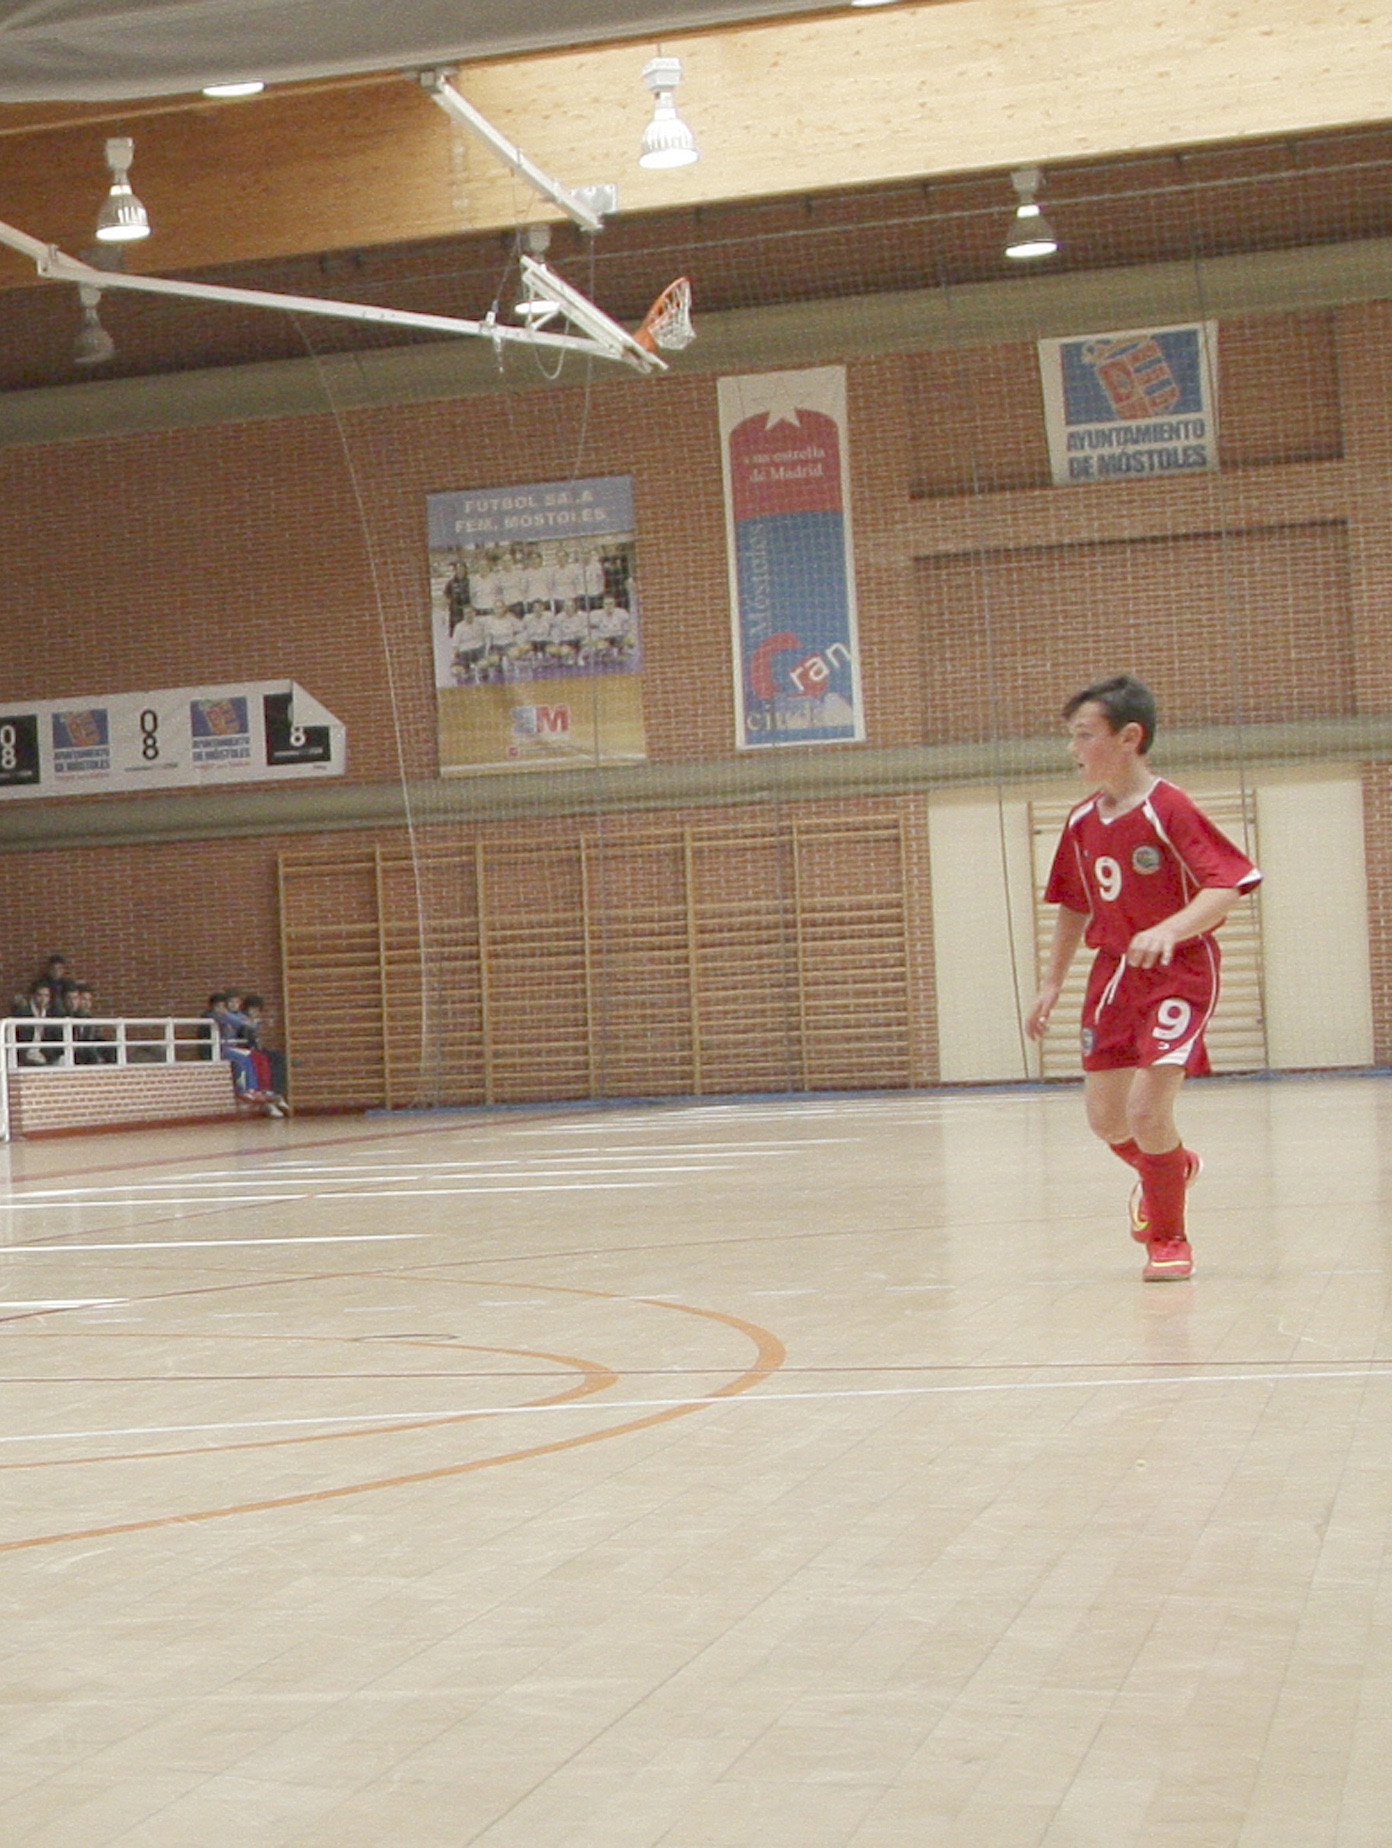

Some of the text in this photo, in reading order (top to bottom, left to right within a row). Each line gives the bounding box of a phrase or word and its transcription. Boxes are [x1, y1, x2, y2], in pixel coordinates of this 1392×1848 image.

[1067, 419, 1206, 451] AYUNTAMIENTO
[1069, 455, 1095, 479] DE
[545, 490, 595, 506] SAA
[1094, 856, 1122, 901] 9
[1152, 997, 1191, 1040] 9
